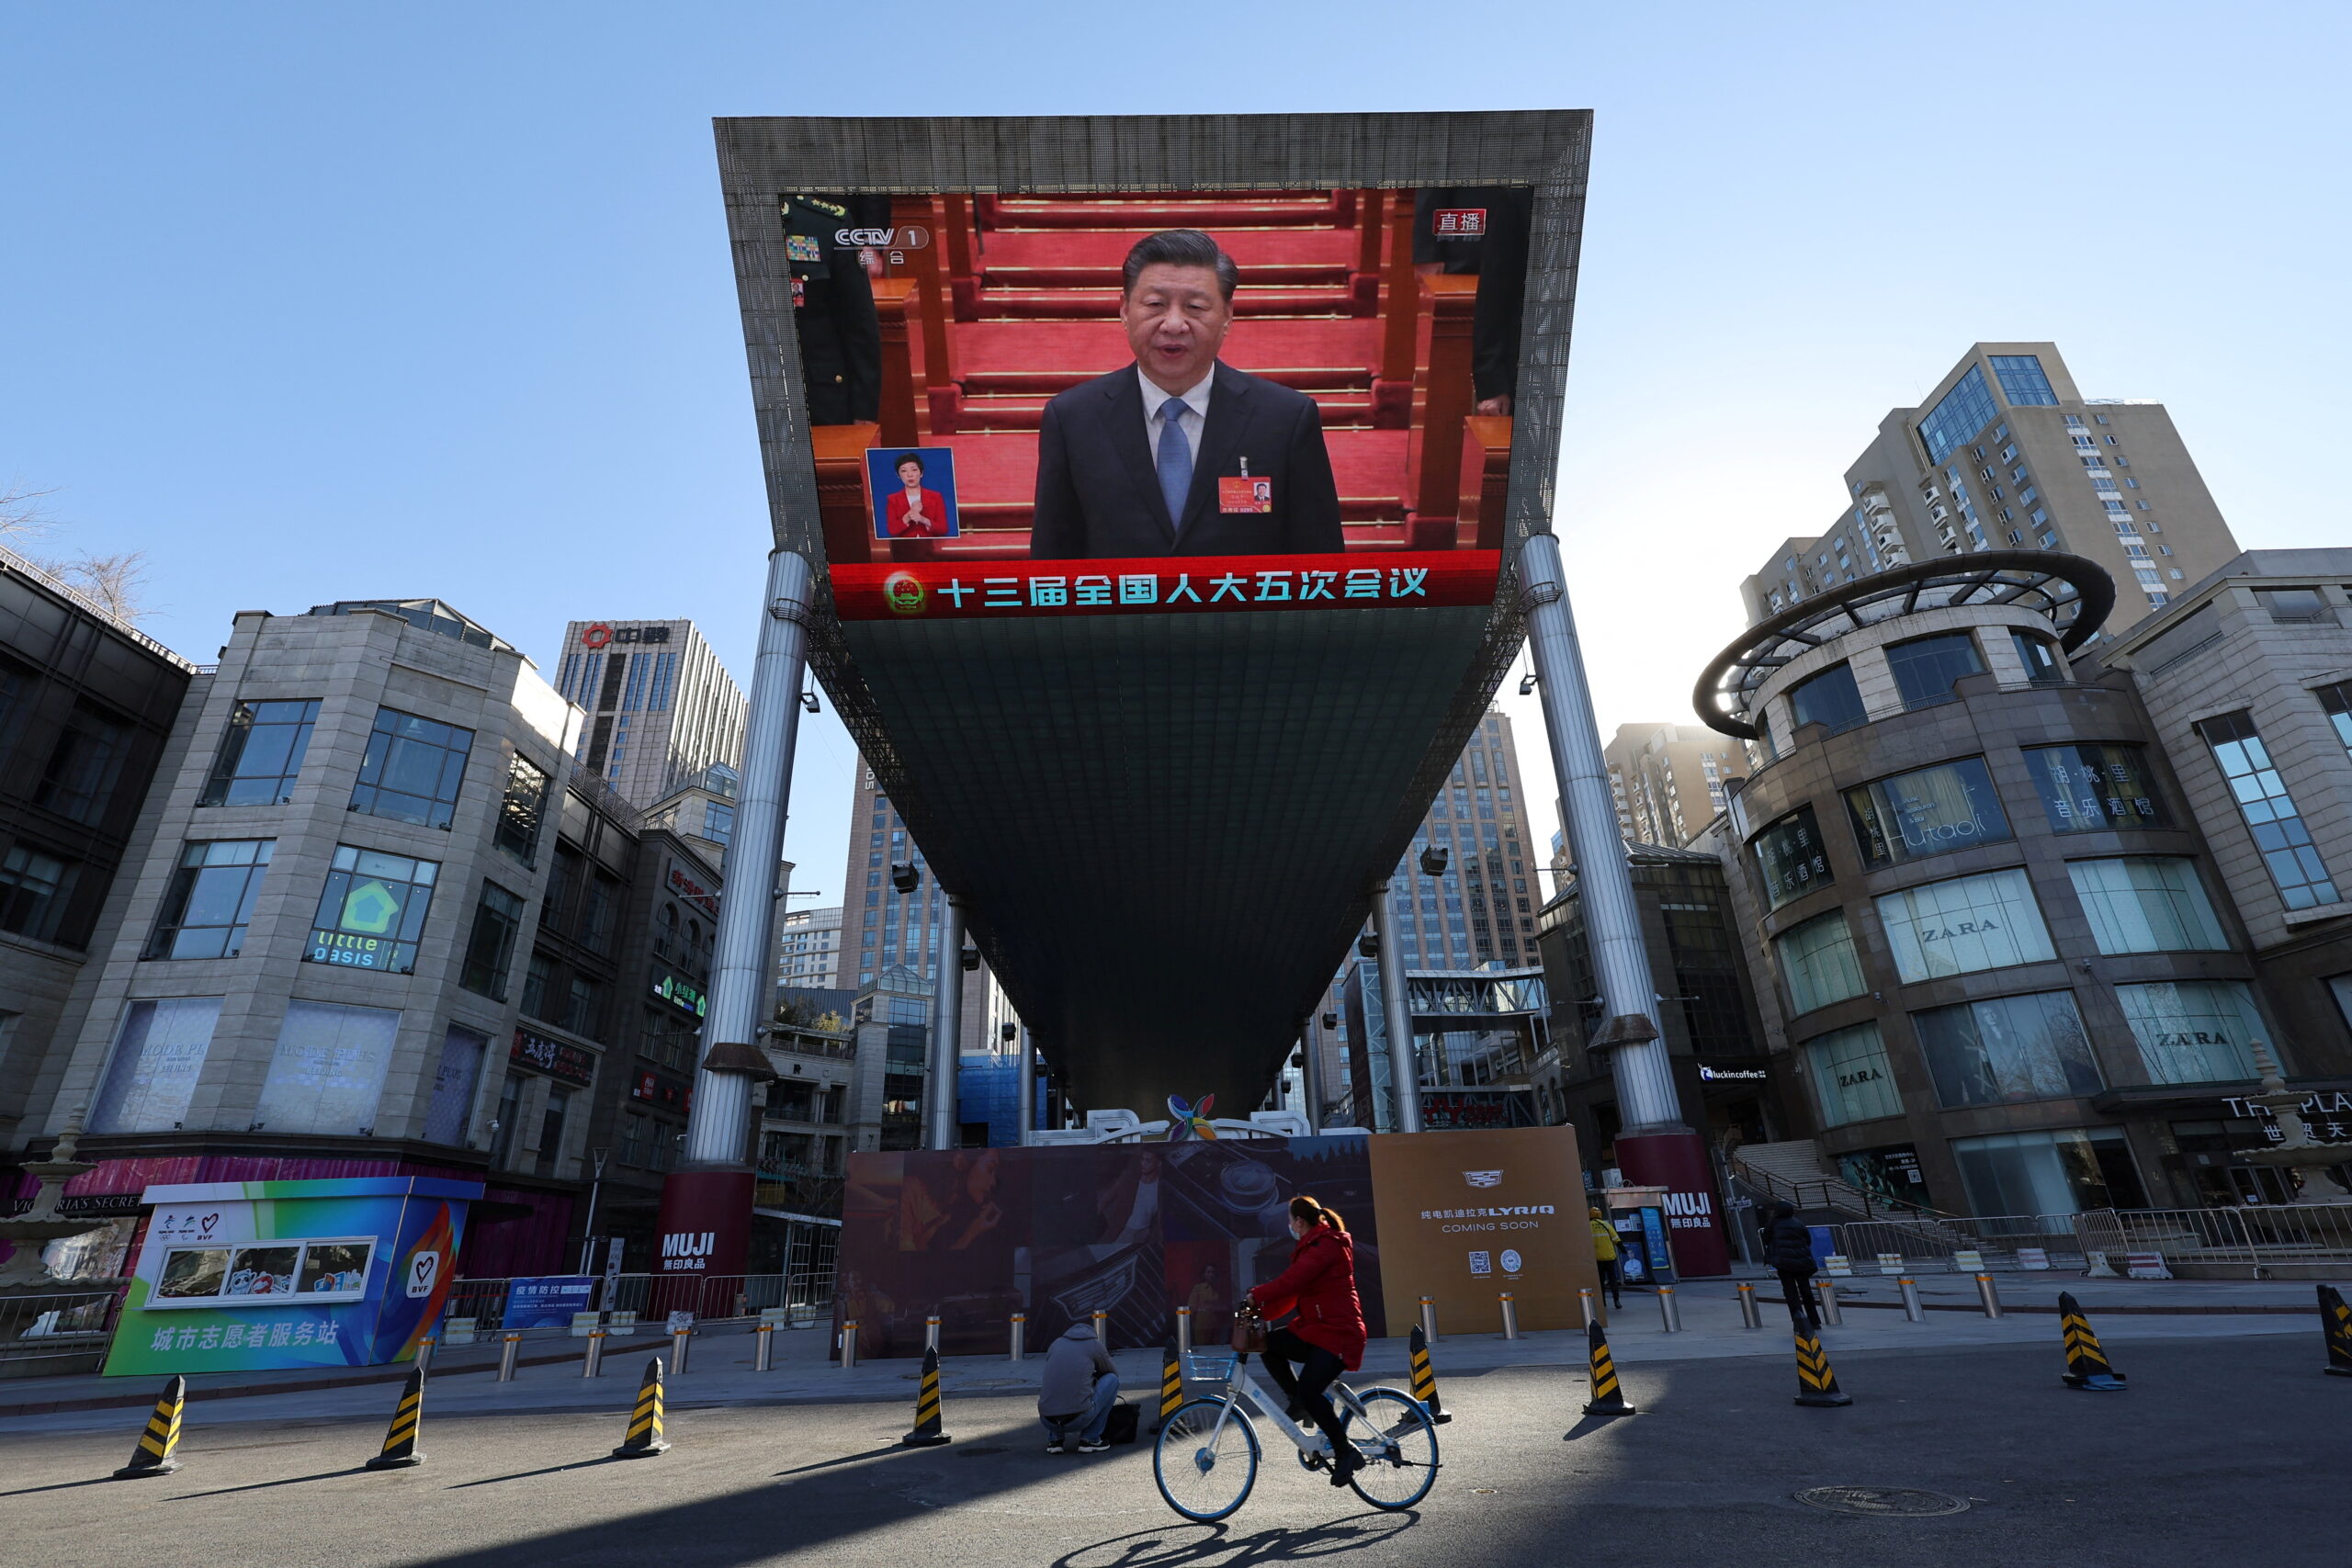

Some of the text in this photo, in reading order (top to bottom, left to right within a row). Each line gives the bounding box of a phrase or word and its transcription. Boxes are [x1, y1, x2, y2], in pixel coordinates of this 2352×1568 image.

[1439, 212, 1480, 231] 直播
[834, 229, 894, 245] CCTV
[936, 567, 1429, 608] 十三届全国人大五次会议
[2054, 796, 2154, 818] 音乐酒馆
[1922, 919, 1999, 942] ZARA
[318, 931, 378, 952] little
[313, 947, 374, 966] oasis
[2155, 1032, 2228, 1047] ZARA
[1839, 1067, 1883, 1088] ZARA
[14, 1197, 89, 1213] VICRIA'S
[1421, 1204, 1555, 1220] 纯电凯迪拉克 LYRIQ
[1662, 1192, 1712, 1216] MUJI
[1442, 1221, 1539, 1233] COMING SOON
[1670, 1217, 1712, 1229] 無印良品
[662, 1232, 715, 1258] MUJI
[663, 1258, 706, 1270] 無印良品
[412, 1286, 429, 1294] BVF
[515, 1285, 561, 1295] 疫情防控
[151, 1319, 340, 1352] 城市志愿者服务站
